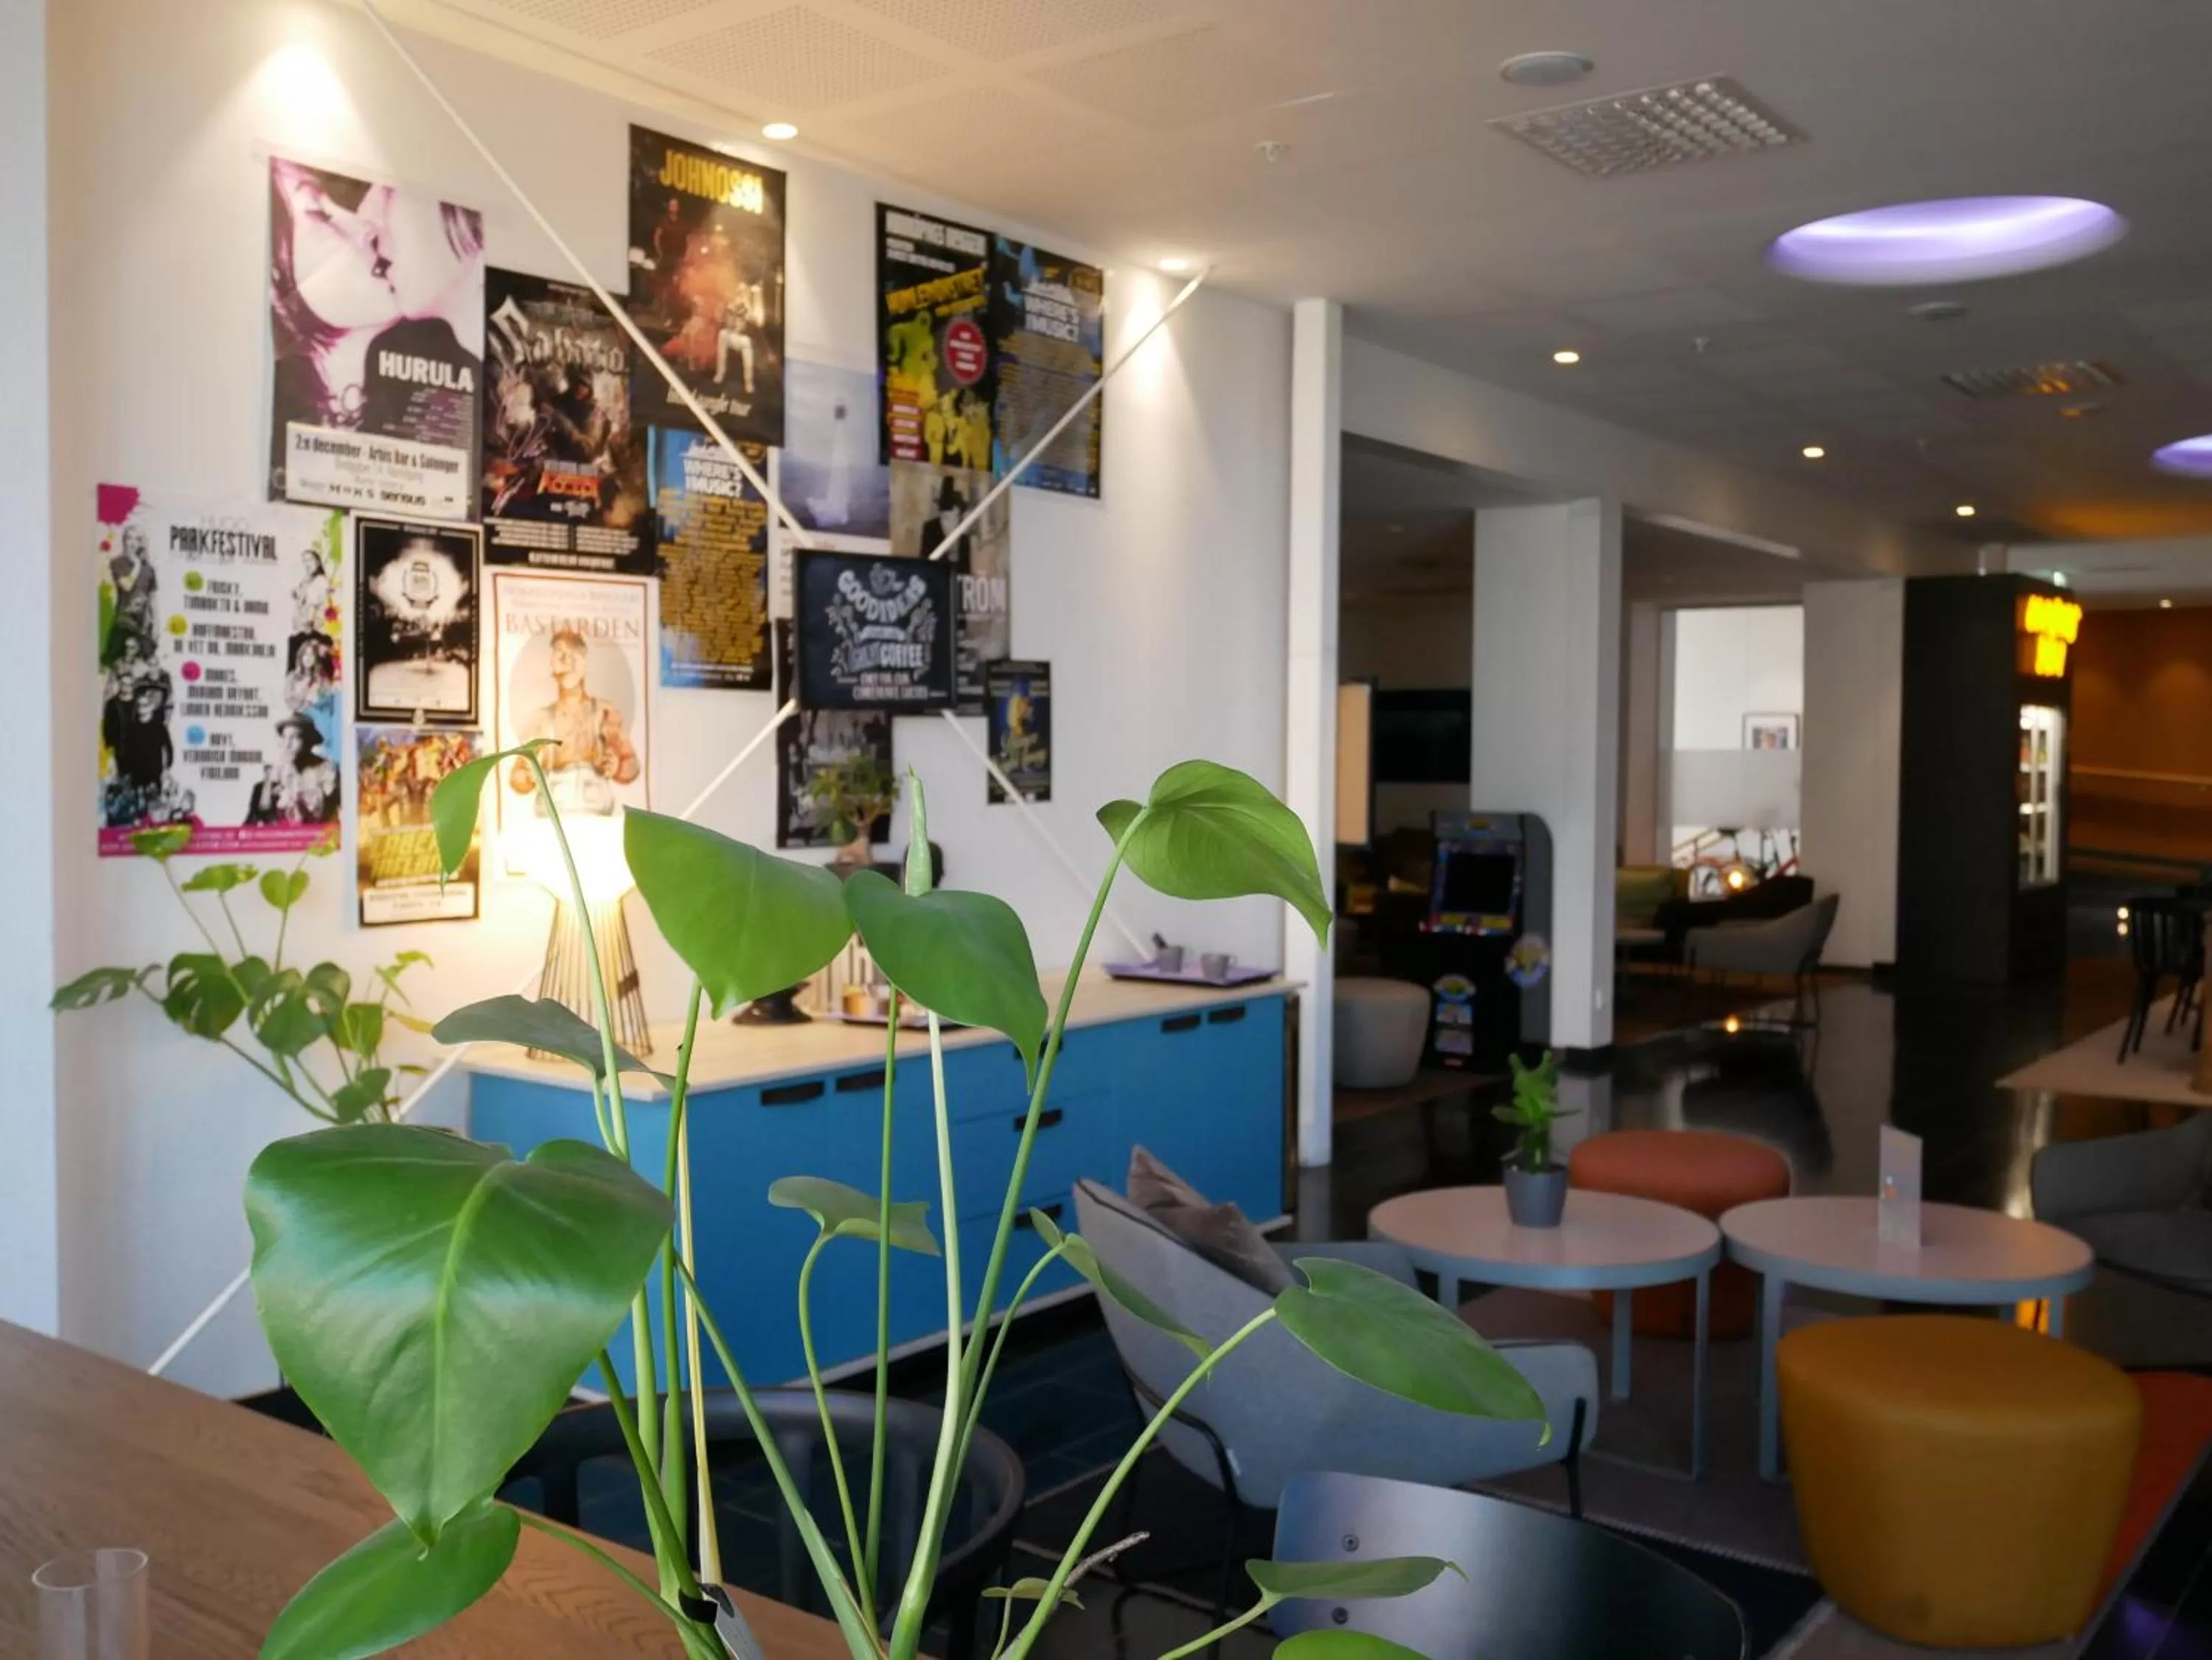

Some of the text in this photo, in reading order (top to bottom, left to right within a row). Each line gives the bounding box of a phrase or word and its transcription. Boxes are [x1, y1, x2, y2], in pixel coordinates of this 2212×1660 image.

[378, 350, 475, 393] HURULA
[838, 570, 879, 621] GOOD
[505, 611, 641, 639] BASTARDEN
